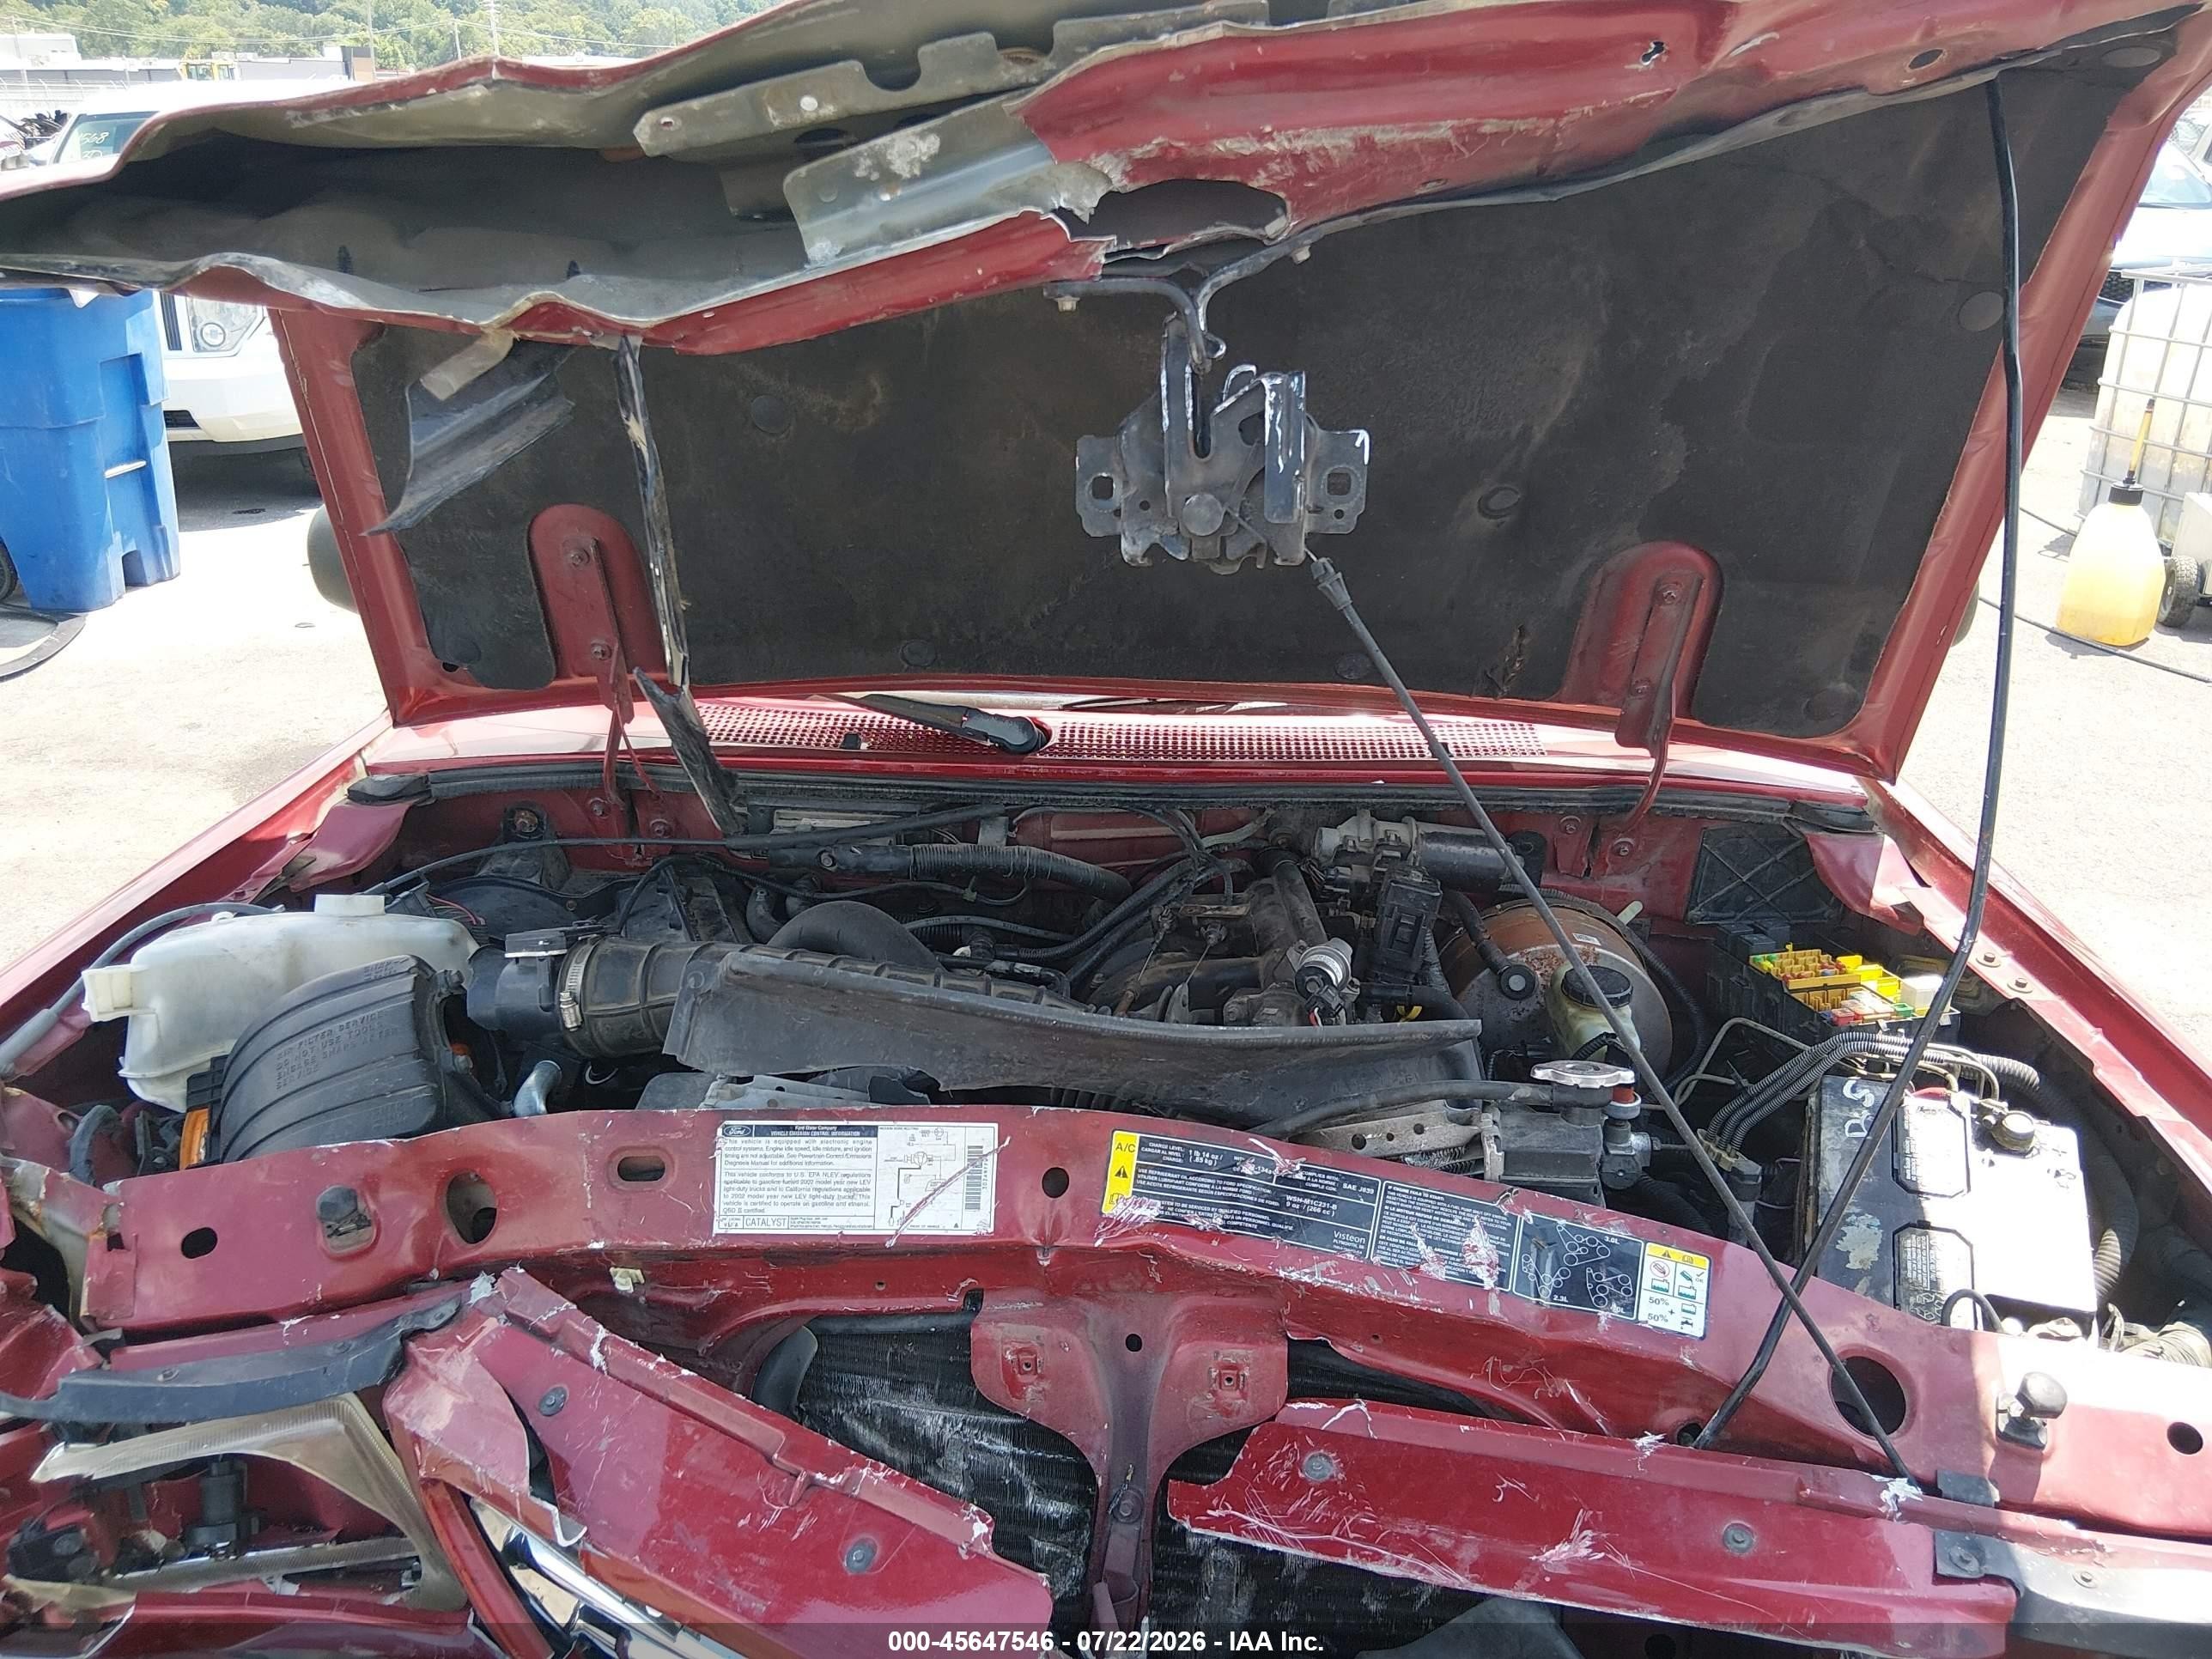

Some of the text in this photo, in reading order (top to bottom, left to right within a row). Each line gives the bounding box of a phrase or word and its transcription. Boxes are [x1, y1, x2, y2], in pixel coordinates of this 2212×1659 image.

[298, 1029, 333, 1047] FILTER
[338, 1012, 385, 1031] SERVICE
[295, 1047, 315, 1061] NOT
[320, 1036, 342, 1048] USE
[1115, 1143, 1135, 1152] A/C
[1148, 1170, 1180, 1179] REFRIGERANT
[1188, 1176, 1216, 1184] ACCORDING
[1185, 1181, 1210, 1189] CONFORME
[1286, 1194, 1338, 1210] WSH-M1C231-B
[745, 1218, 787, 1227] CATALYST
[1226, 1220, 1258, 1229] COMPETENTE
[1242, 1217, 1270, 1226] PERSONNEL
[1334, 1231, 1365, 1243] Visteon
[1604, 1237, 1620, 1245] 3.0L
[1553, 1294, 1569, 1303] 2.3L
[1649, 1297, 1669, 1306] 50%
[1648, 1313, 1668, 1322] 50%
